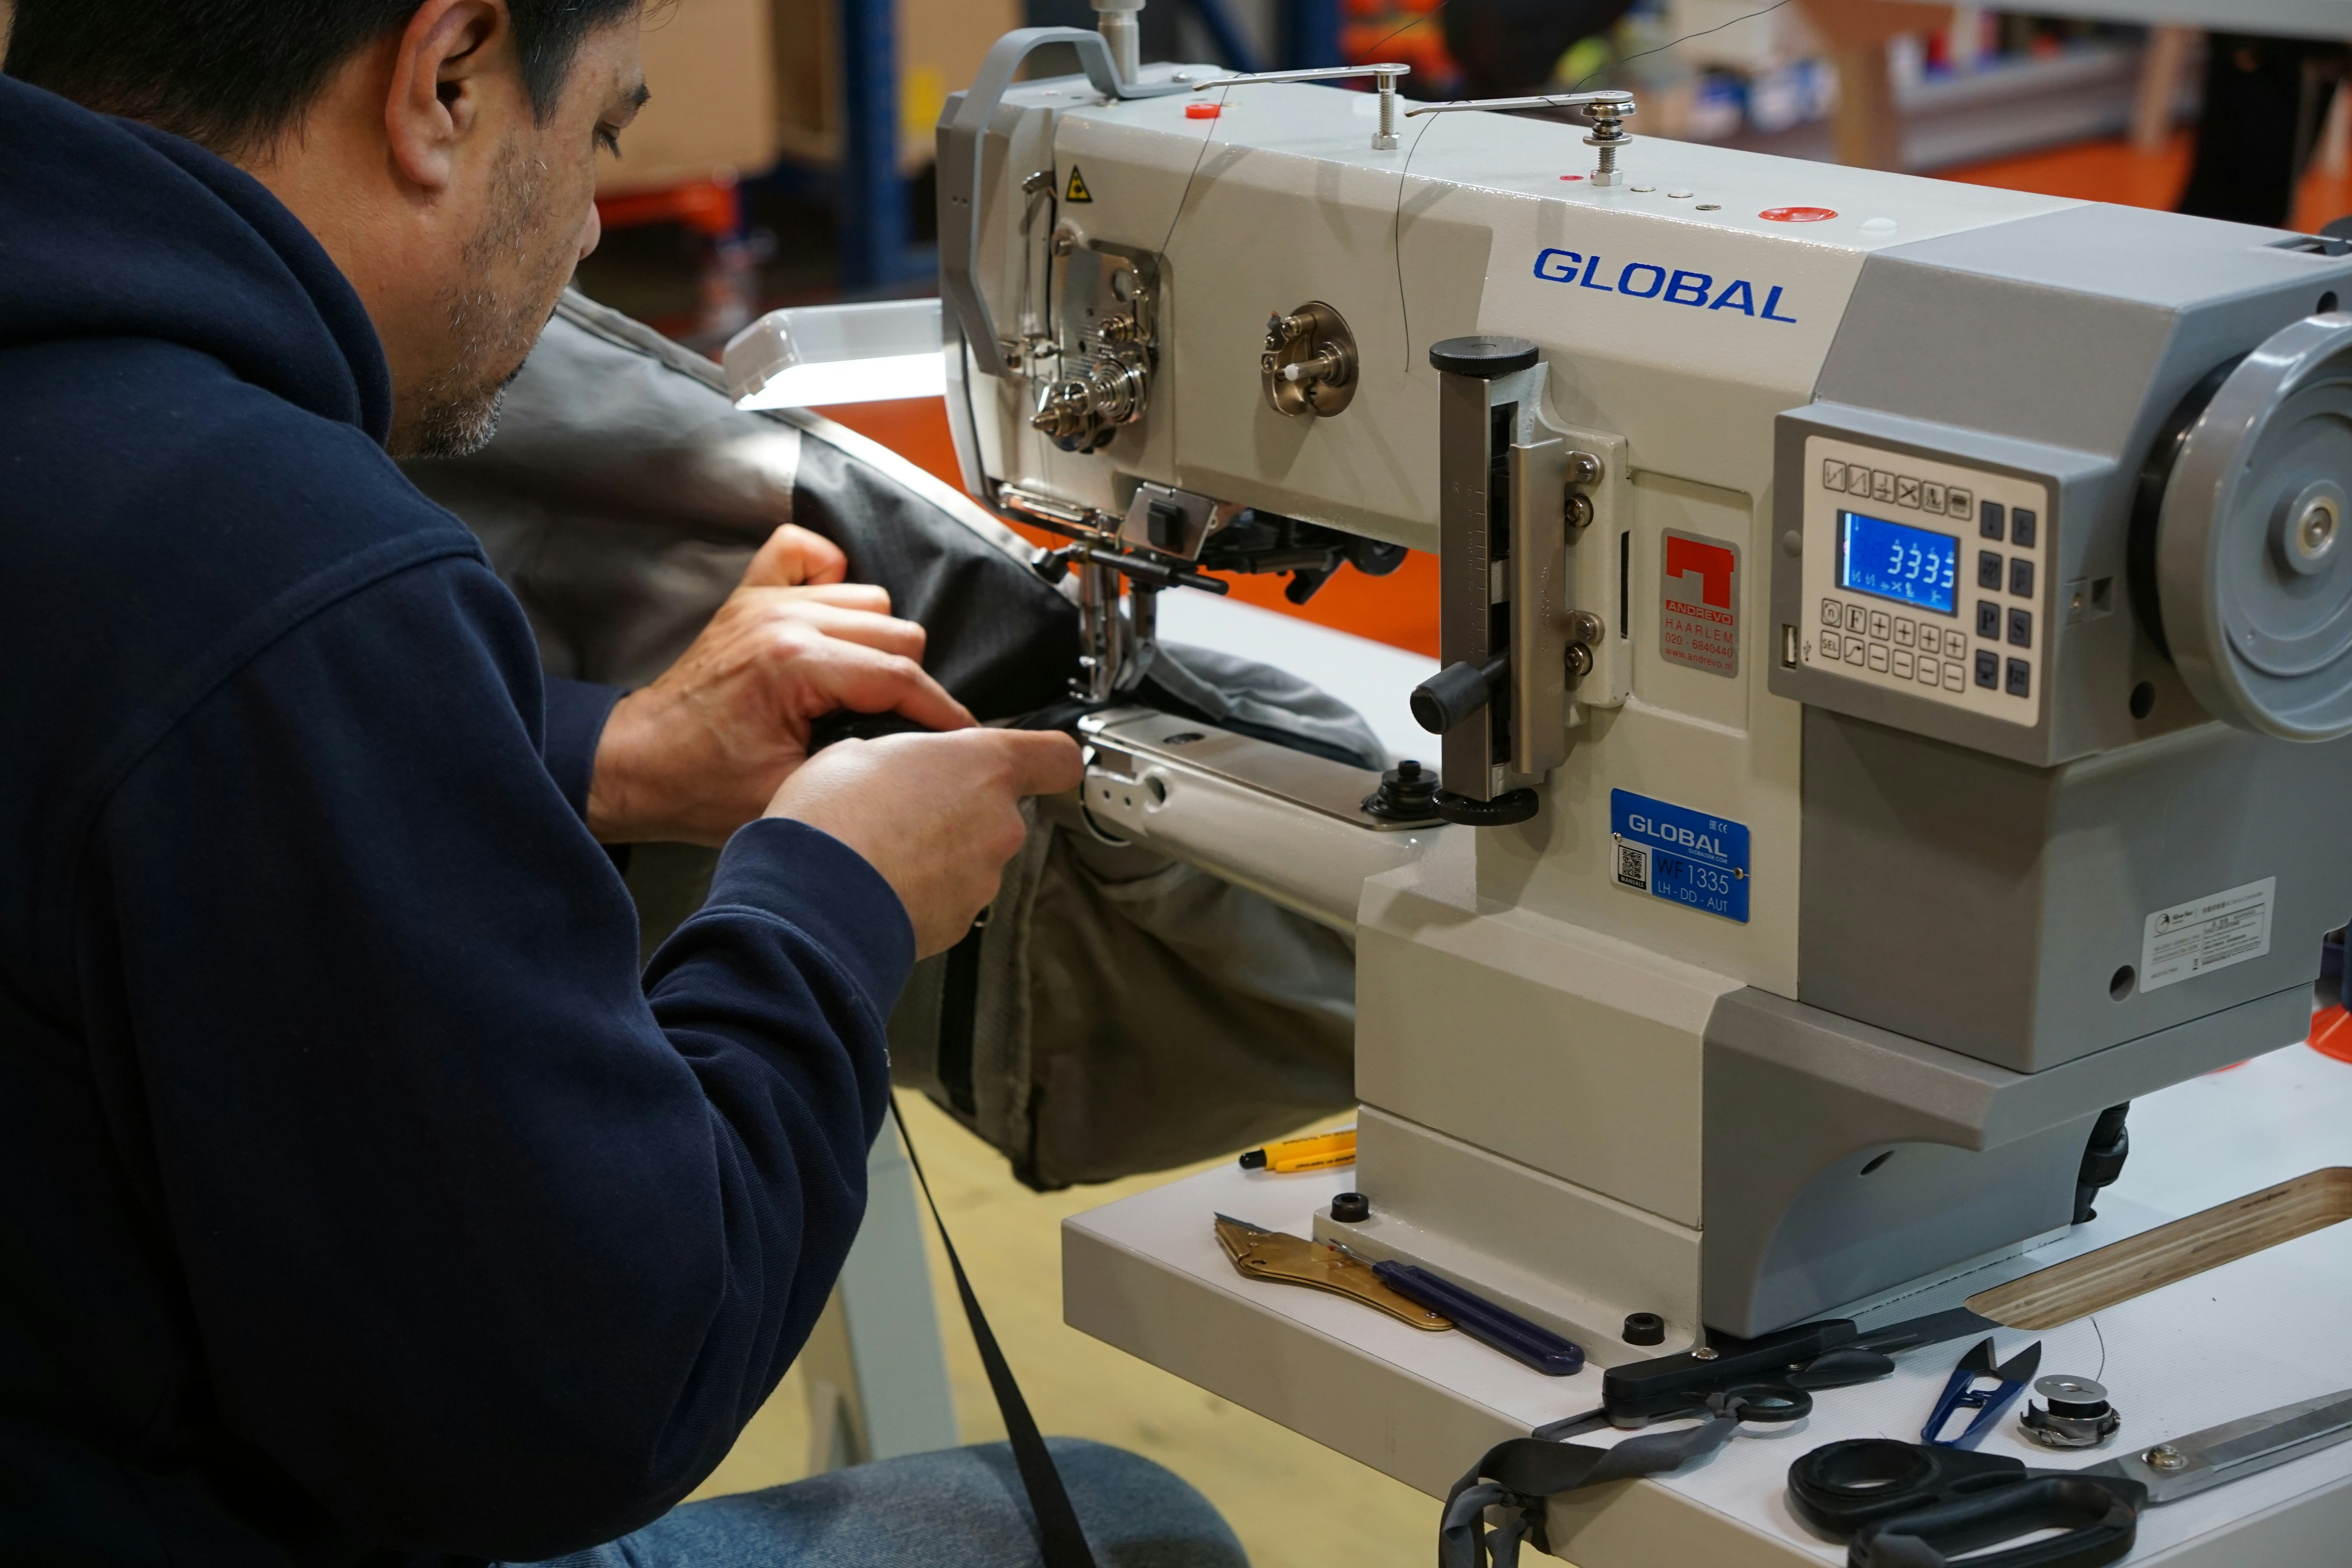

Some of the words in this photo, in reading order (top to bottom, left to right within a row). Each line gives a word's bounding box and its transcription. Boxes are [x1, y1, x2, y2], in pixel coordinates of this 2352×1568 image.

[1534, 248, 1797, 323] GLOBAL
[1667, 602, 1731, 624] ANDREVO
[1849, 609, 1863, 629] F
[1982, 610, 1995, 630] P
[1665, 617, 1733, 643] HAARLEM
[2013, 617, 2025, 639] S
[1665, 632, 1682, 645] 020
[1692, 639, 1733, 658] 6840440
[1823, 639, 1838, 652] SEL
[1629, 814, 1728, 858] GLOBAL
[1620, 876, 1644, 887] MANUALS
[1657, 855, 1684, 880] WF
[1688, 865, 1729, 895] 1335
[1658, 881, 1670, 895] LH
[1681, 888, 1697, 902] DD
[1707, 897, 1728, 913] AUT
